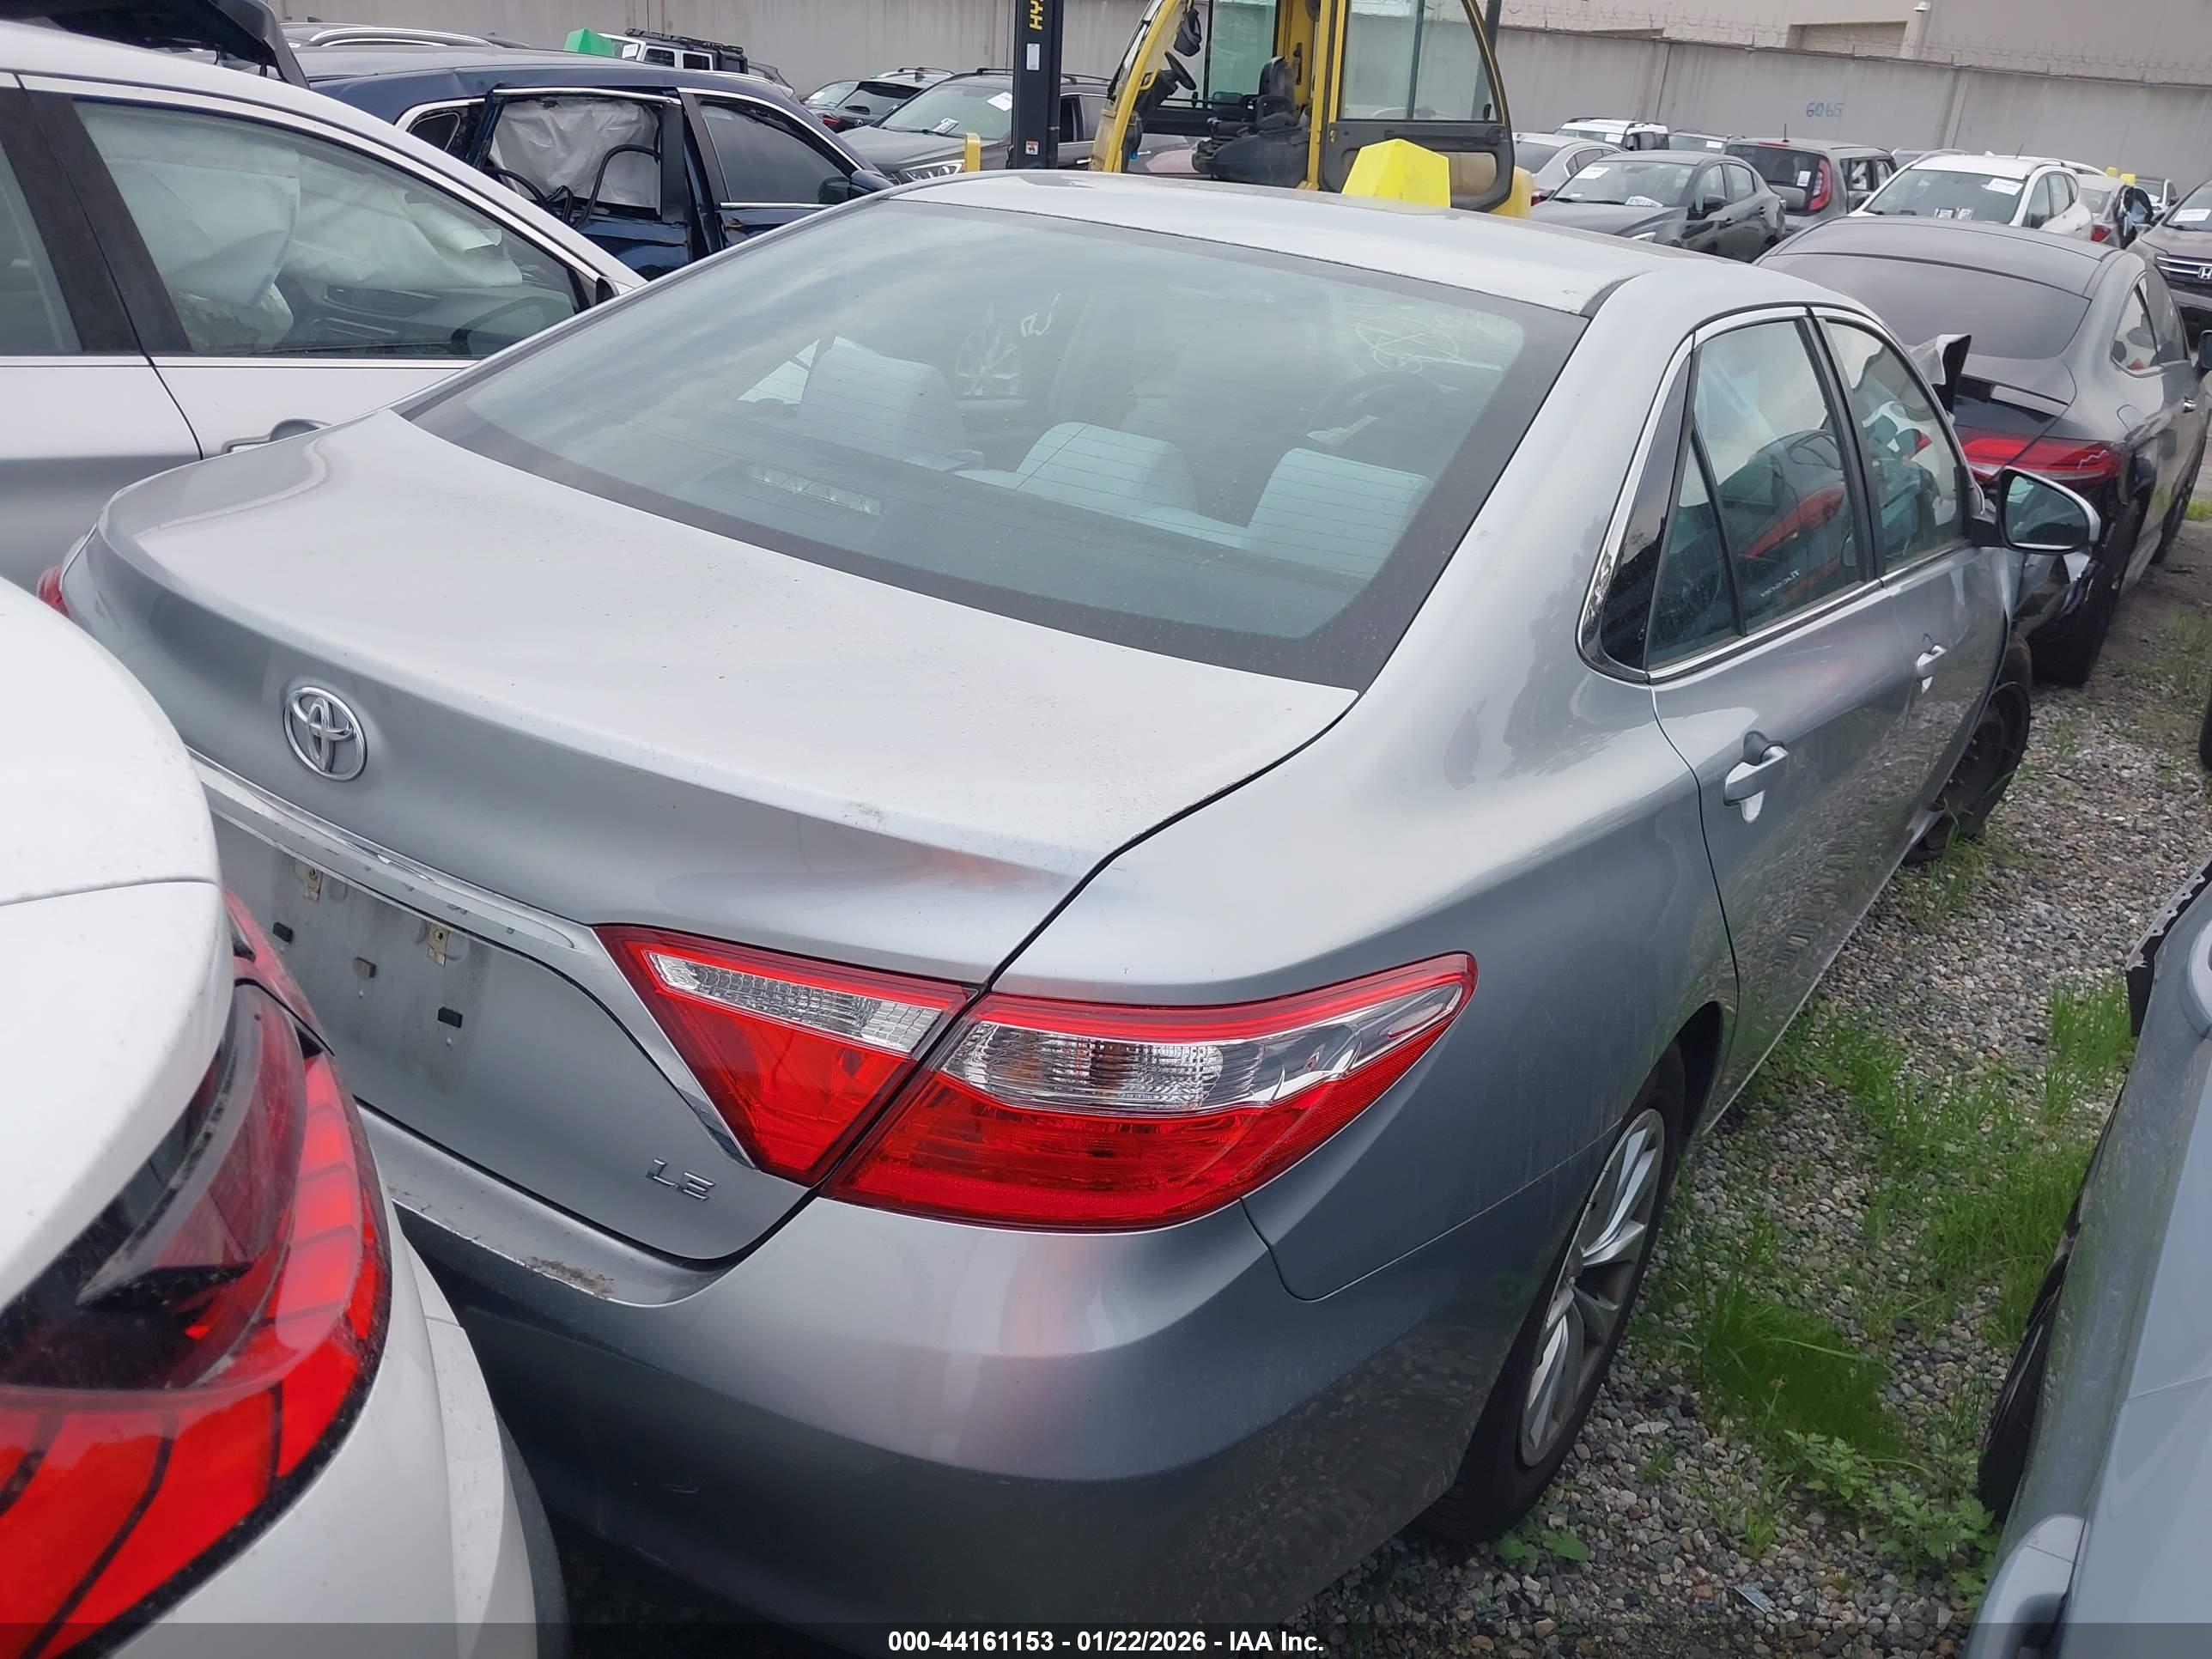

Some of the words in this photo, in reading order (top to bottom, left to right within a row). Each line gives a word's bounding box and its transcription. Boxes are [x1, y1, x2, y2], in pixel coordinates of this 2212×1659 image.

[1029, 0, 1044, 31] HY
[1805, 100, 1844, 118] 6065
[646, 1158, 716, 1202] LE
